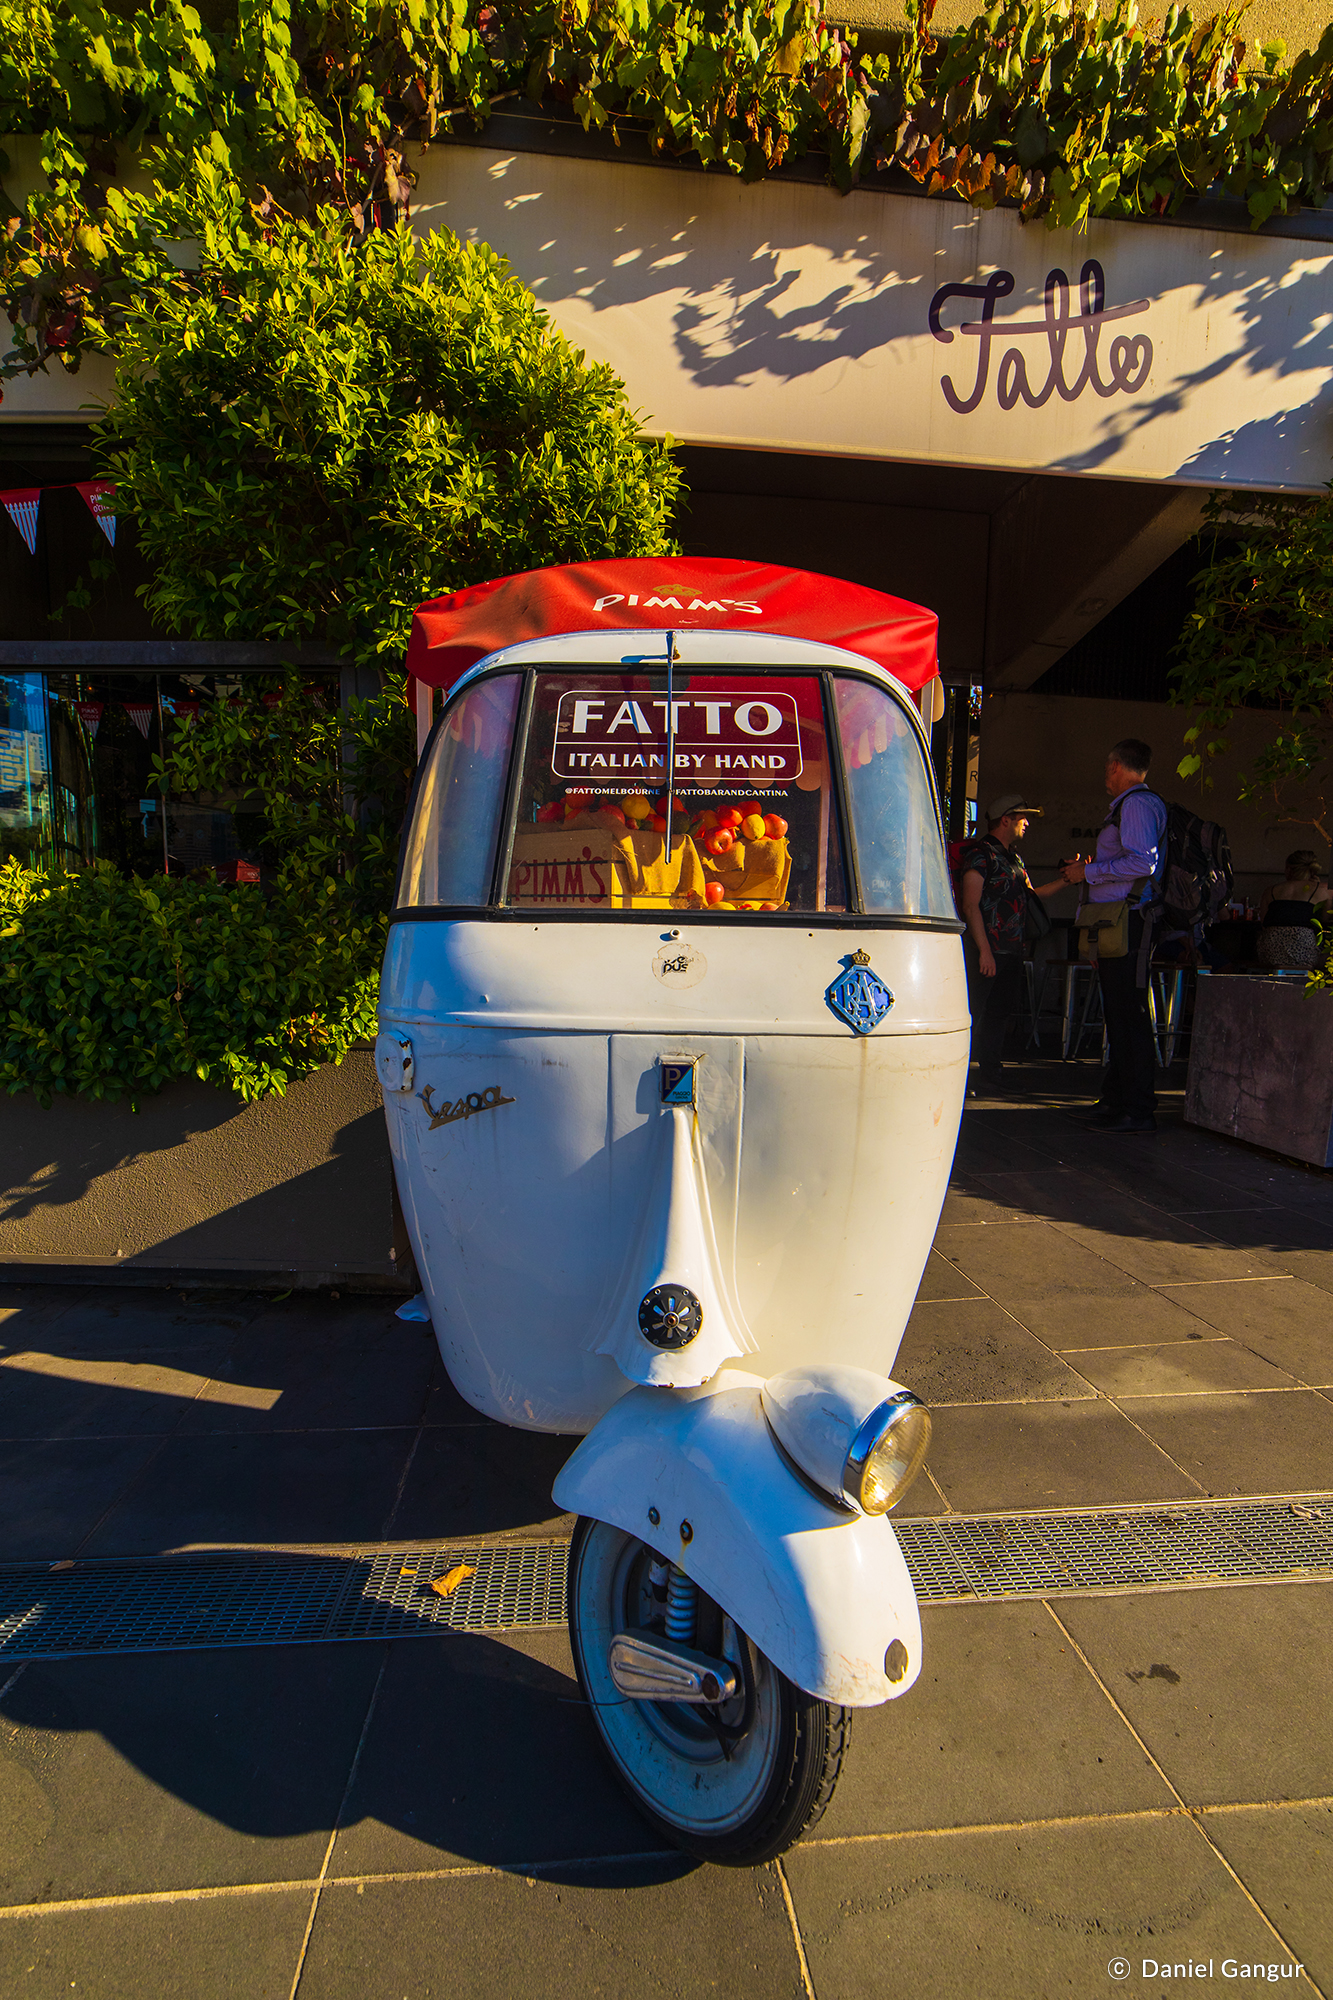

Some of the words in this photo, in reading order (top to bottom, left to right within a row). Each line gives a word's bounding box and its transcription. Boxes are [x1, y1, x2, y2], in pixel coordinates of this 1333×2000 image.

[592, 594, 763, 614] PIMM'S
[572, 700, 783, 736] FATTO
[568, 753, 664, 768] ITALIAN
[674, 754, 706, 769] BY
[715, 754, 787, 769] HAND
[565, 787, 660, 795] @FATTOMELBOURNE
[514, 846, 606, 904] PIMM'S
[841, 971, 887, 1019] RAC
[664, 1067, 682, 1090] P
[415, 1083, 516, 1131] Vespa
